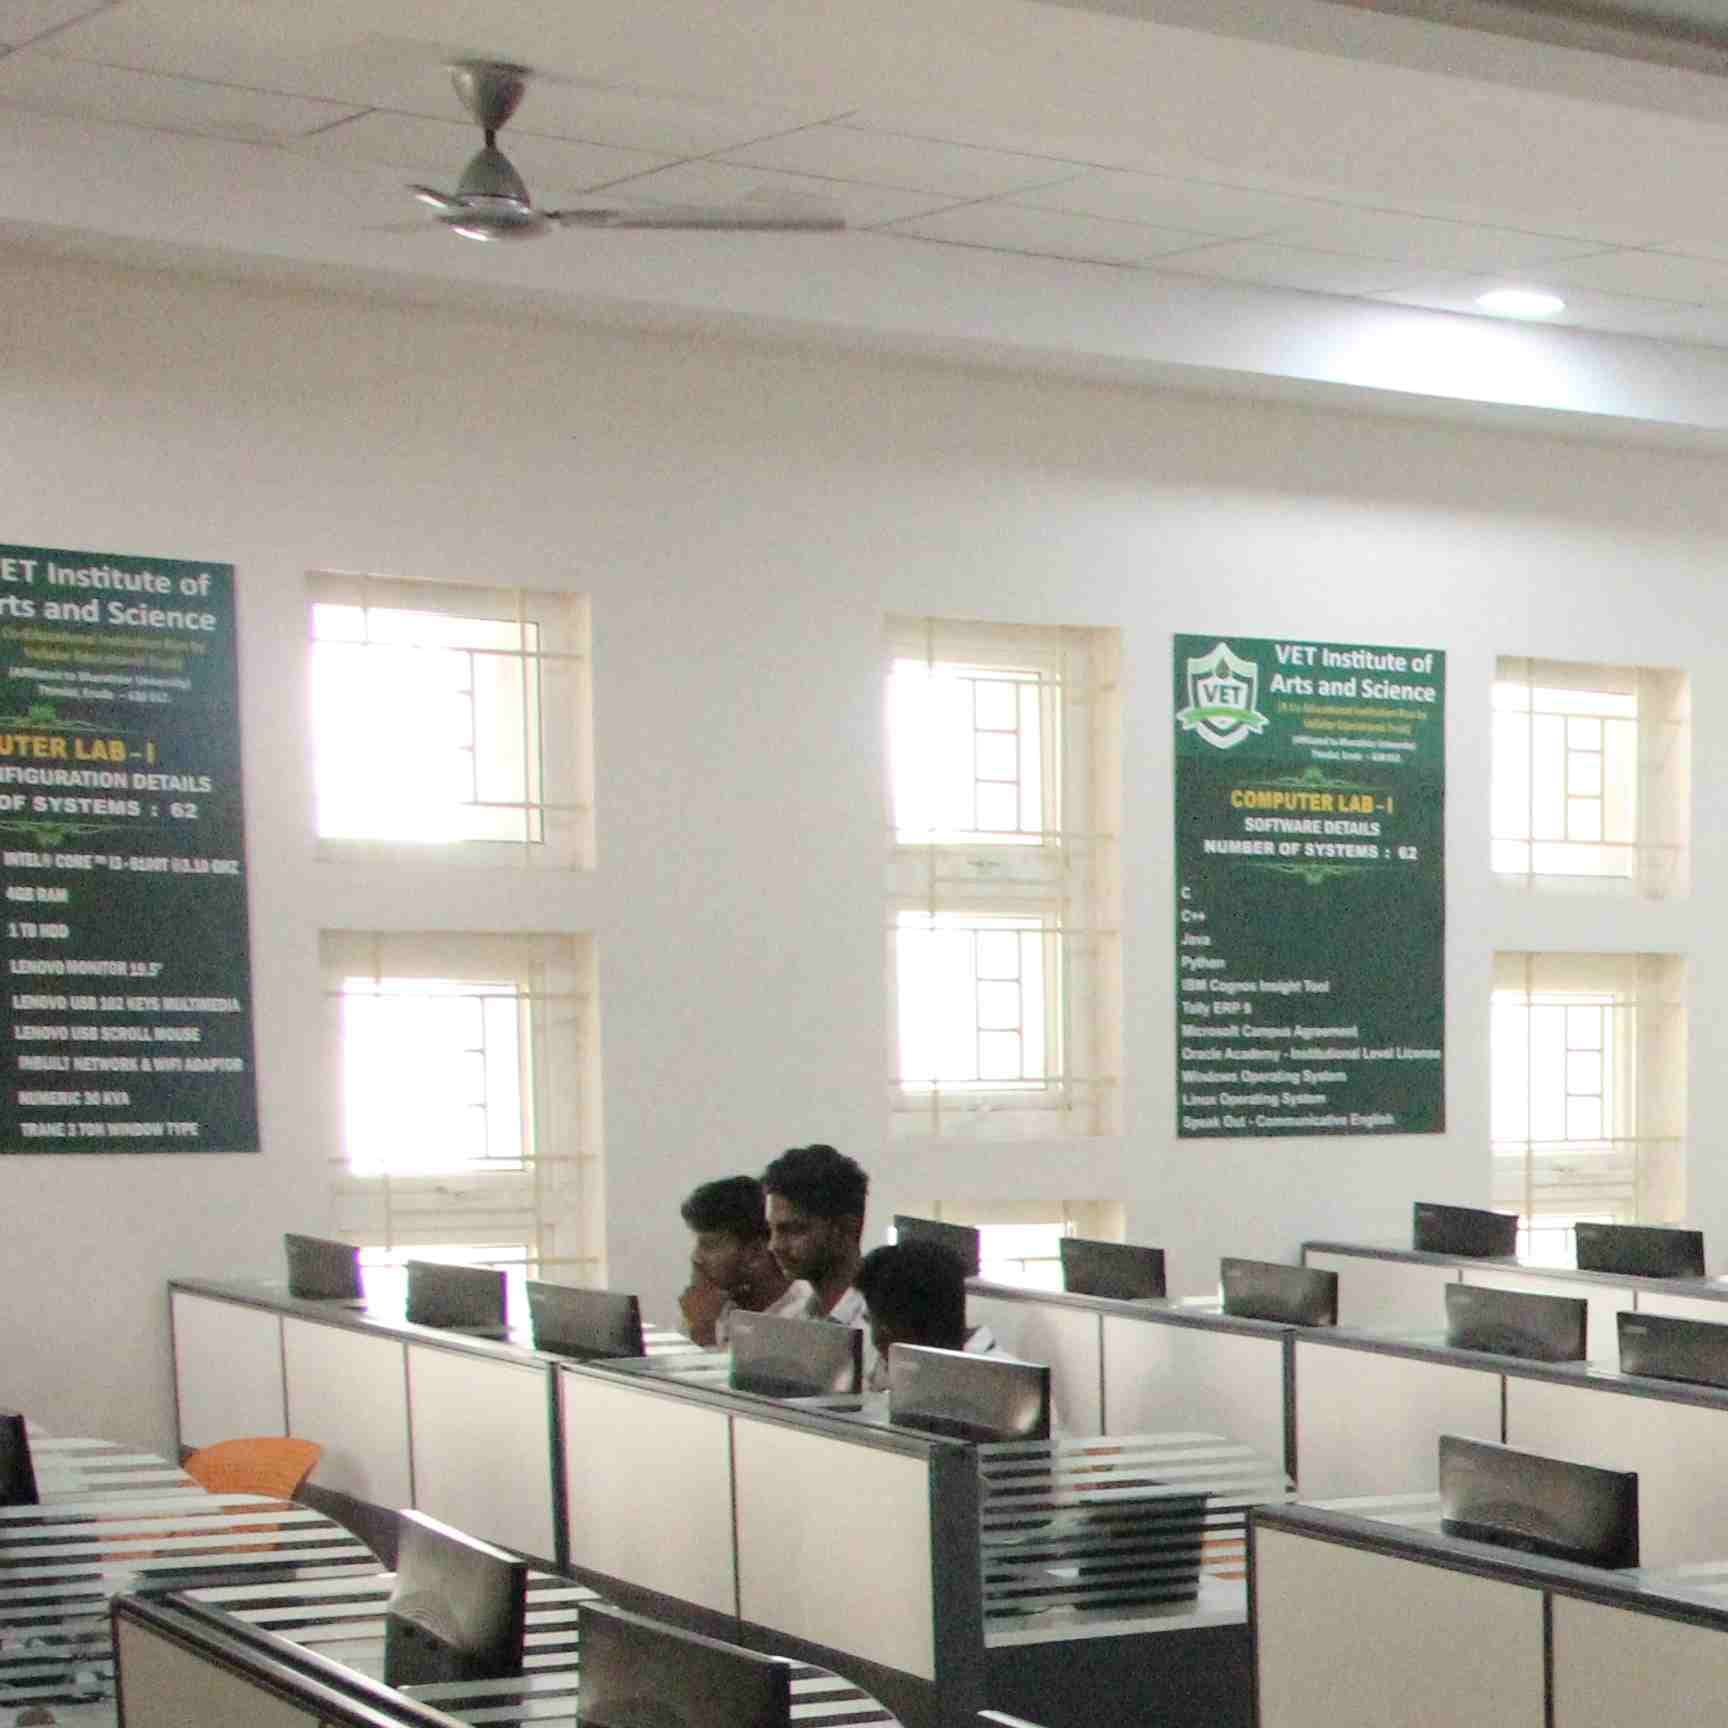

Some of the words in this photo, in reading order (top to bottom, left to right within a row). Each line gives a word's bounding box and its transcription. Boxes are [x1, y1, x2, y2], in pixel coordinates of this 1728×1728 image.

[47, 562, 171, 595] Institute
[180, 574, 211, 596] of
[44, 597, 99, 623] and
[107, 601, 216, 631] Science
[1275, 644, 1317, 666] VET
[1322, 648, 1408, 672] Institute
[1411, 653, 1434, 674] of
[1203, 684, 1243, 703] VET
[1269, 673, 1313, 696] Arts
[1317, 677, 1357, 699] and
[1361, 679, 1437, 703] Science
[75, 738, 126, 762] LAB
[133, 772, 212, 793] DETAILS
[0, 794, 26, 811] OF
[32, 796, 140, 816] SYSTEMS
[151, 804, 158, 816] :
[170, 803, 198, 818] 62
[1231, 789, 1335, 813] COMPUTER
[1338, 794, 1376, 814] LAB
[1244, 816, 1323, 836] SOFTWARE
[1323, 820, 1382, 837] DETAILS
[1203, 838, 1275, 856] NUMBER
[1278, 842, 1301, 857] OF
[1304, 843, 1379, 860] SYSTEMS
[1397, 846, 1418, 861] 62
[1181, 886, 1191, 900] C
[1181, 909, 1206, 923] C++
[1181, 932, 1211, 947] Java
[10, 959, 64, 975] LENOVO
[65, 960, 127, 976] MONITOR
[1181, 955, 1226, 971] Python
[1304, 979, 1330, 993] Tool
[12, 995, 67, 1010] LENOVO
[69, 995, 97, 1011] USB
[1212, 1001, 1241, 1016] ERP
[15, 1025, 68, 1040] LENOVO
[70, 1026, 98, 1040] USB
[100, 1026, 153, 1041] SCROLL
[154, 1026, 200, 1042] MOUSE
[73, 1056, 139, 1072] NETWORK
[1181, 1069, 1238, 1084] Windows
[1240, 1070, 1301, 1086] Operating
[1302, 1070, 1348, 1086] System
[1219, 1093, 1279, 1108] Operating
[1281, 1093, 1327, 1107] System
[108, 1122, 165, 1137] WINDOW
[166, 1122, 200, 1138] TYPE
